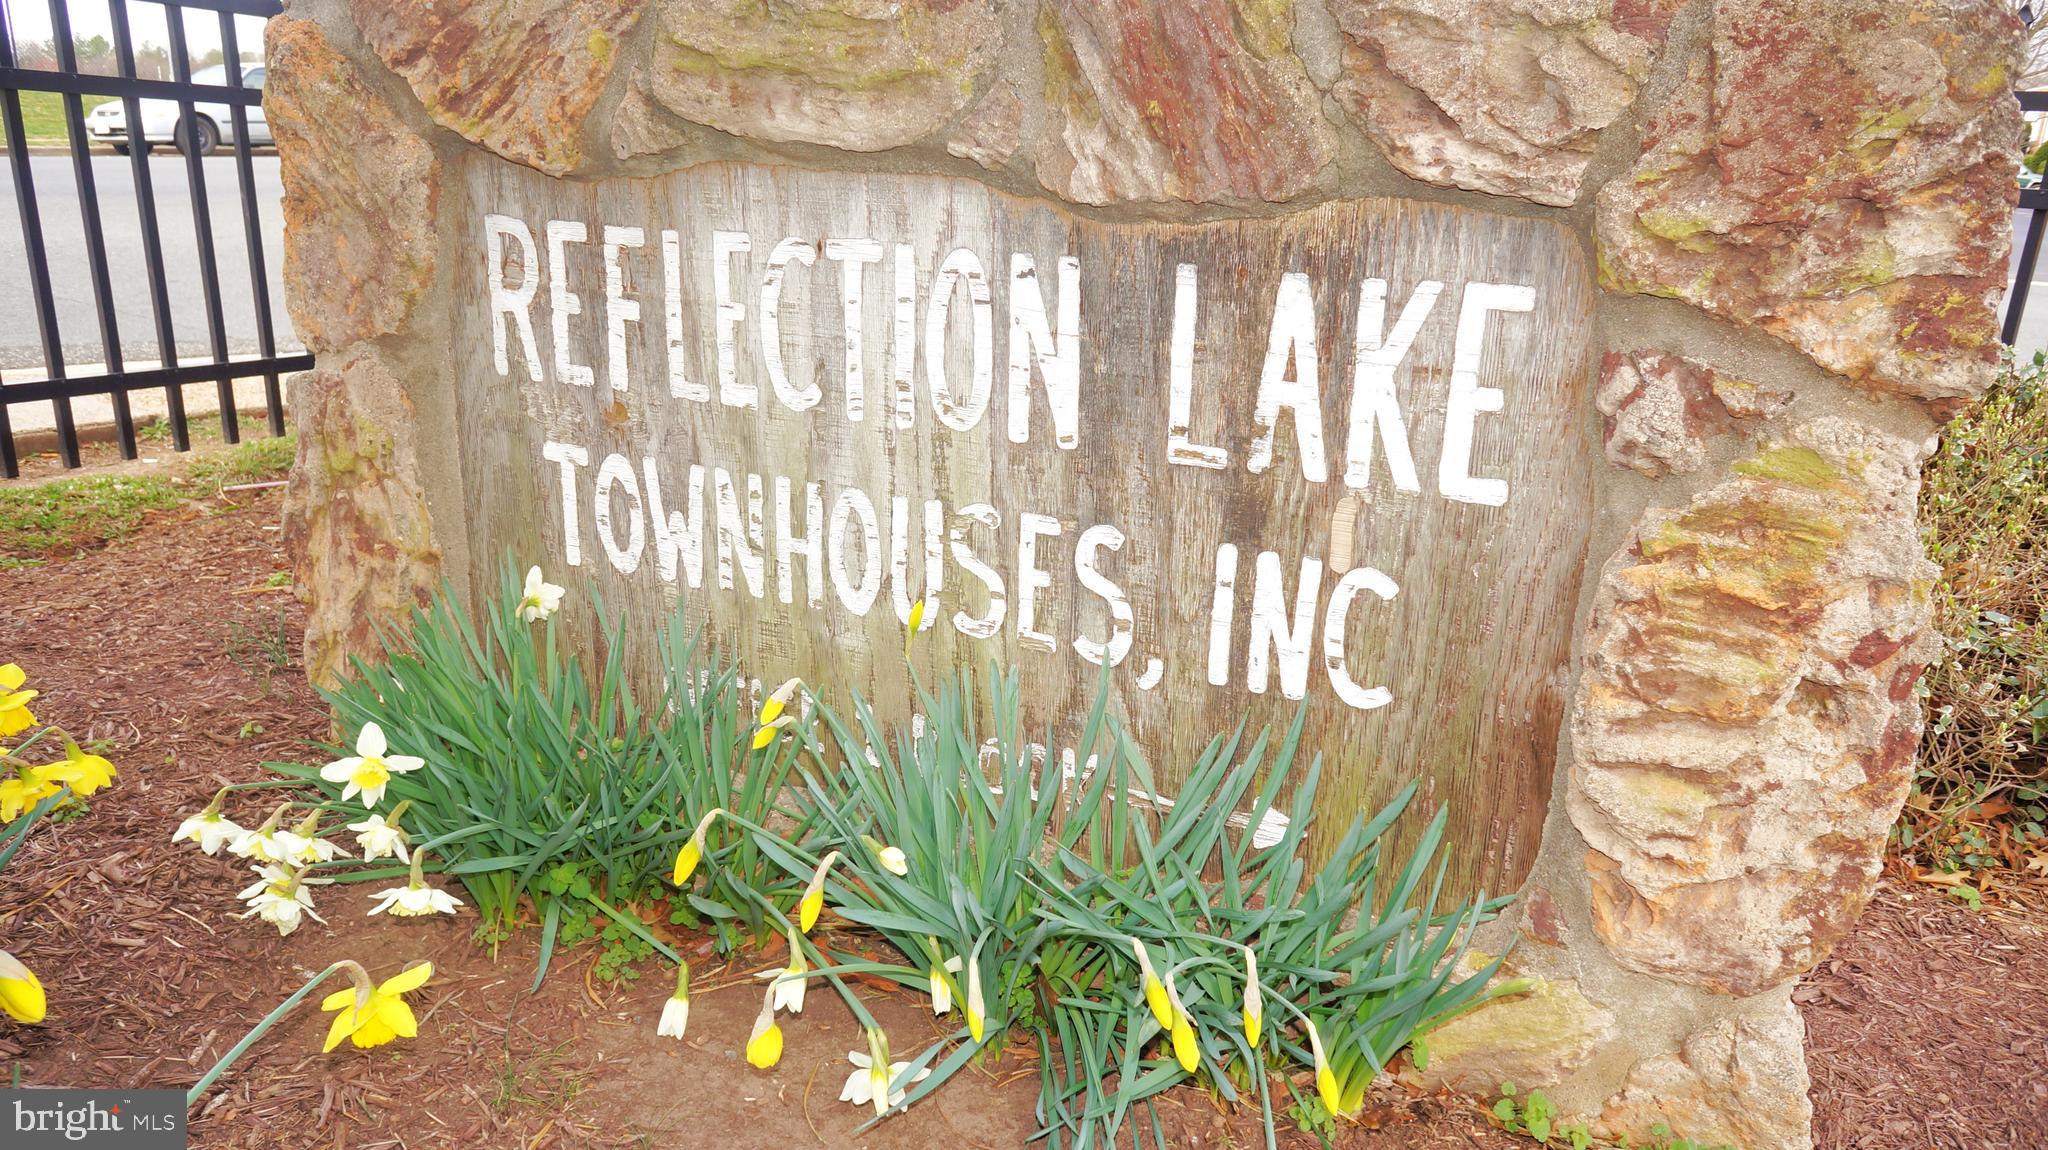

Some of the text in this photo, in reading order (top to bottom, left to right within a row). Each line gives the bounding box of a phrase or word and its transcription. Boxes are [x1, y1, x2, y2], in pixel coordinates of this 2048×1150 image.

[484, 213, 1537, 507] REFLECTION LAKE
[542, 440, 1400, 710] TOWNHOUSES, INC
